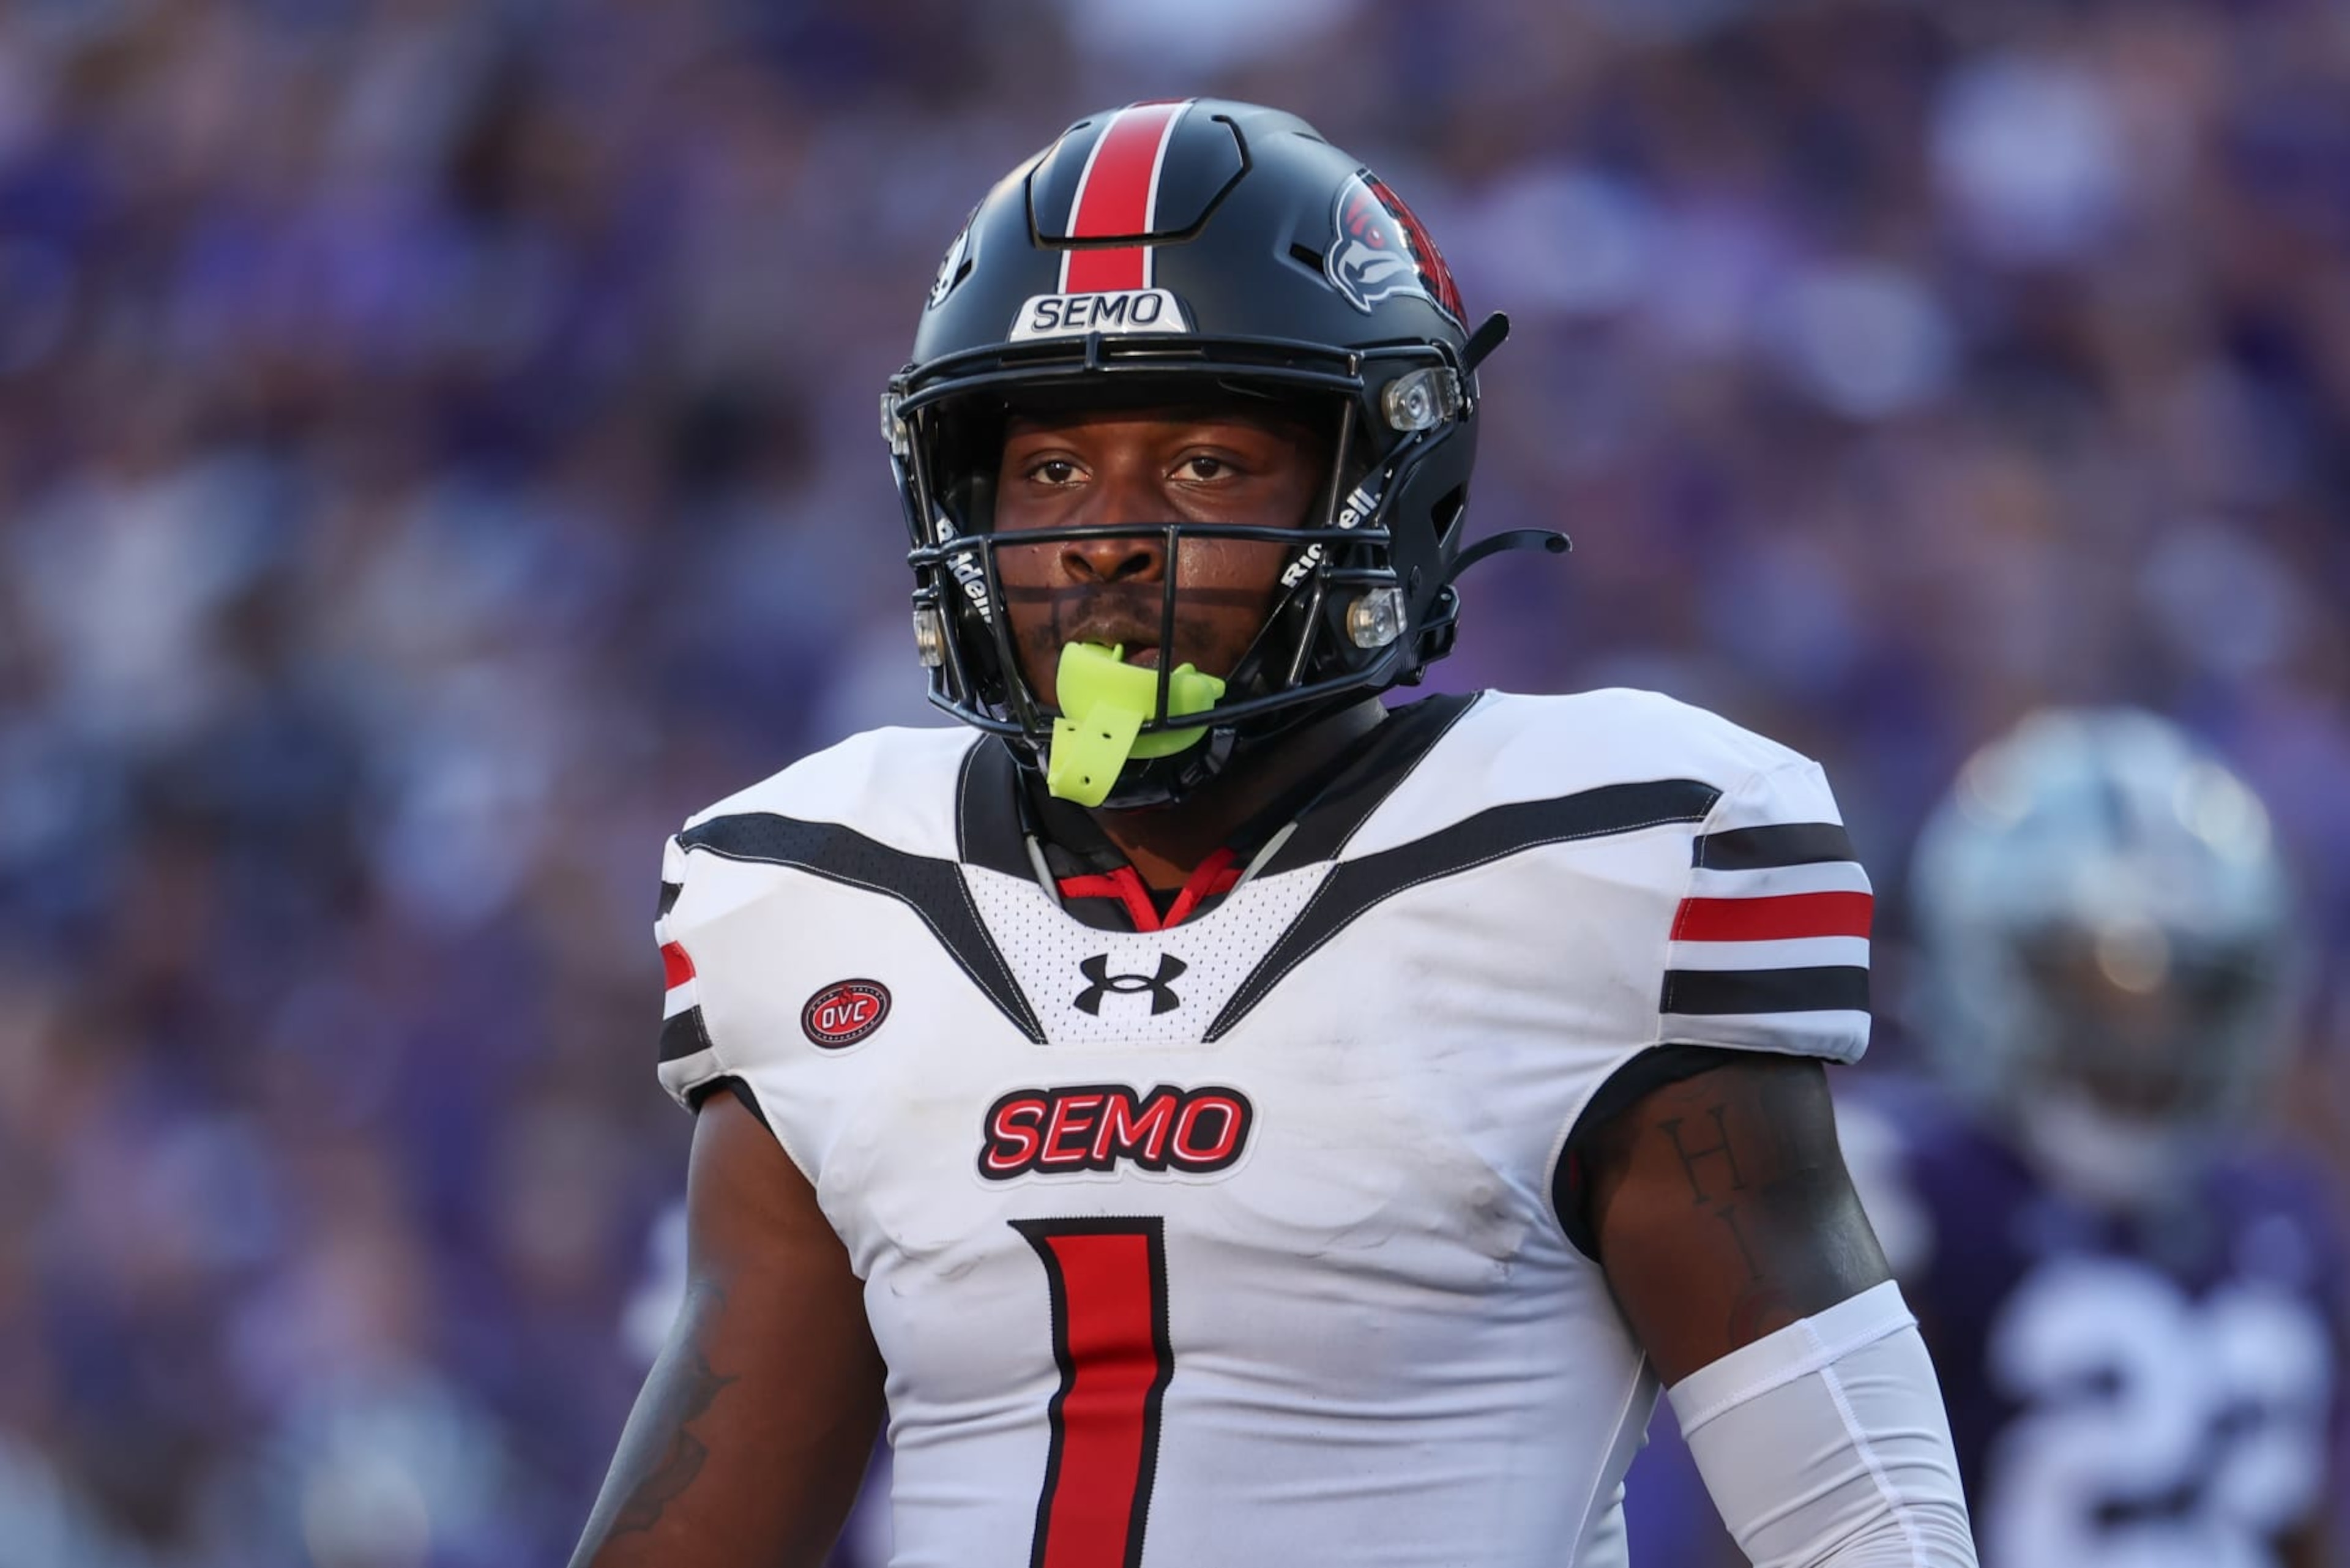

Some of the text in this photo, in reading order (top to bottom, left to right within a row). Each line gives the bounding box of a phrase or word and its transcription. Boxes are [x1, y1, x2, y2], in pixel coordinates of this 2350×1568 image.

[1032, 293, 1162, 333] SEMO
[821, 999, 868, 1029] OVC
[981, 1087, 1251, 1177] SEMO
[1007, 1216, 1174, 1568] 1
